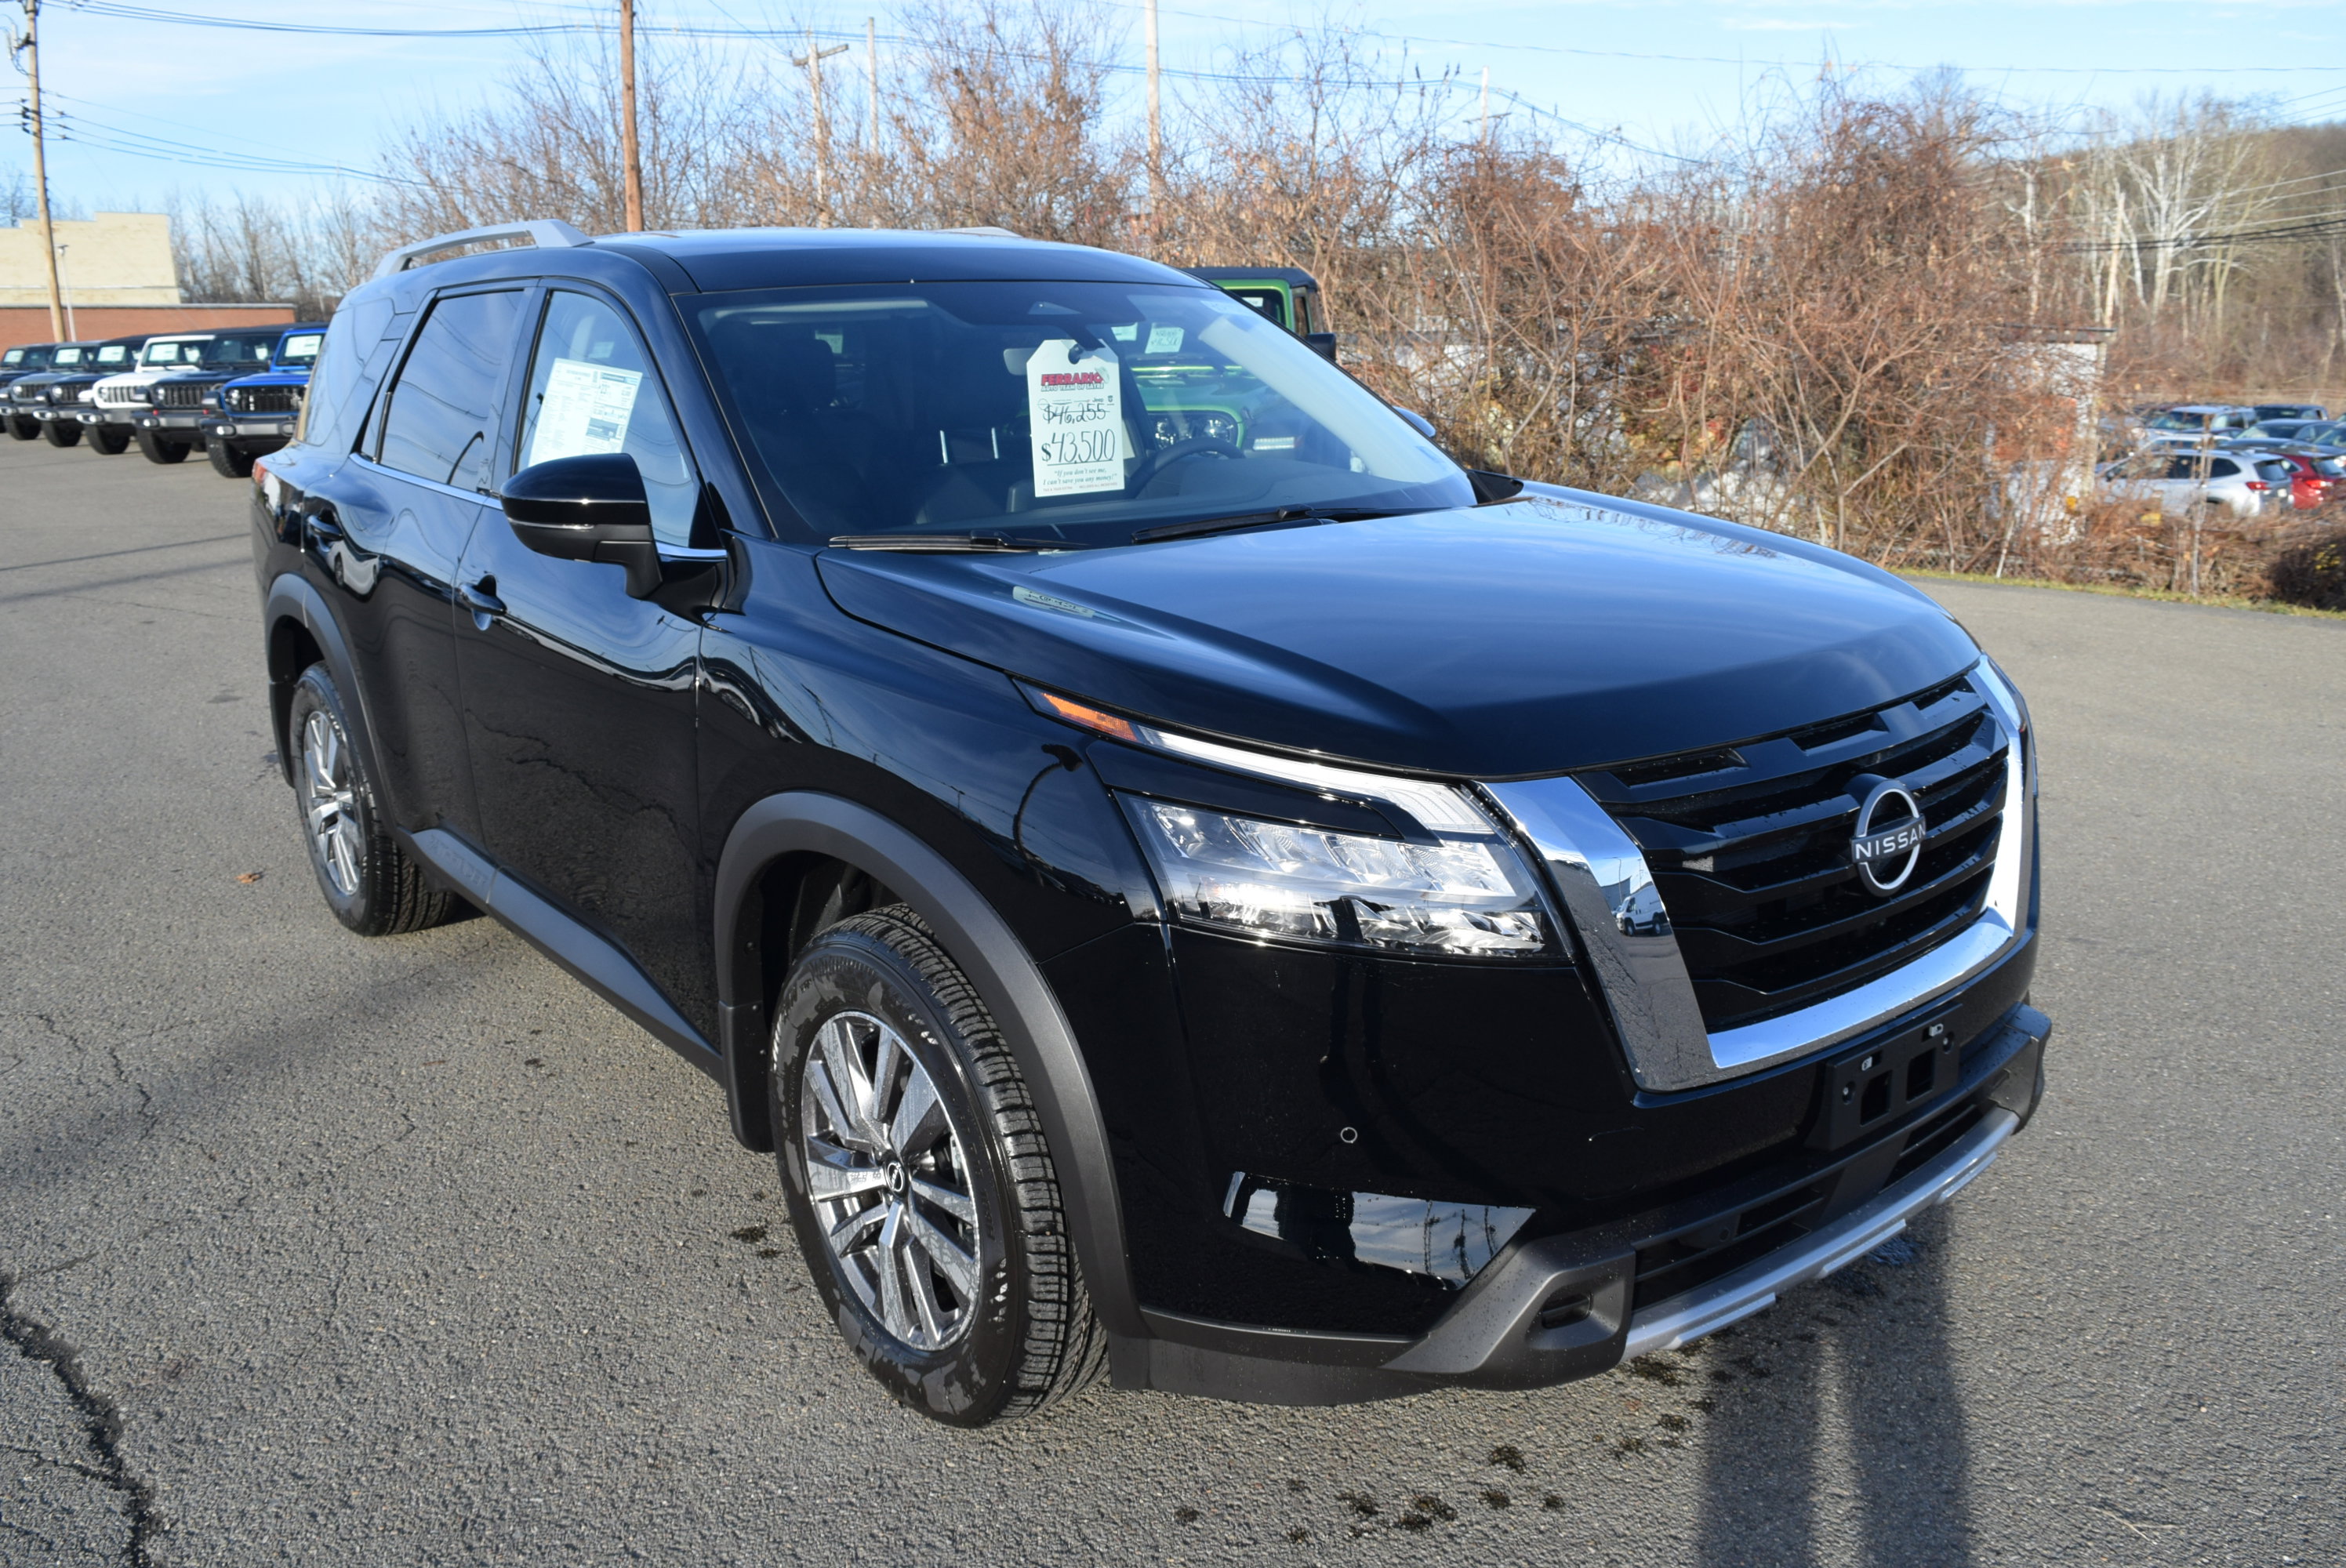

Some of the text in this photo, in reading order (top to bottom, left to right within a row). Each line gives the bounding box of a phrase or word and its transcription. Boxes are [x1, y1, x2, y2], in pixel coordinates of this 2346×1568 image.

[1041, 372, 1104, 387] FERRARIO
[1043, 402, 1106, 424] $46,255
[1041, 429, 1115, 464] $43,500
[1855, 824, 1927, 859] NISSAN
